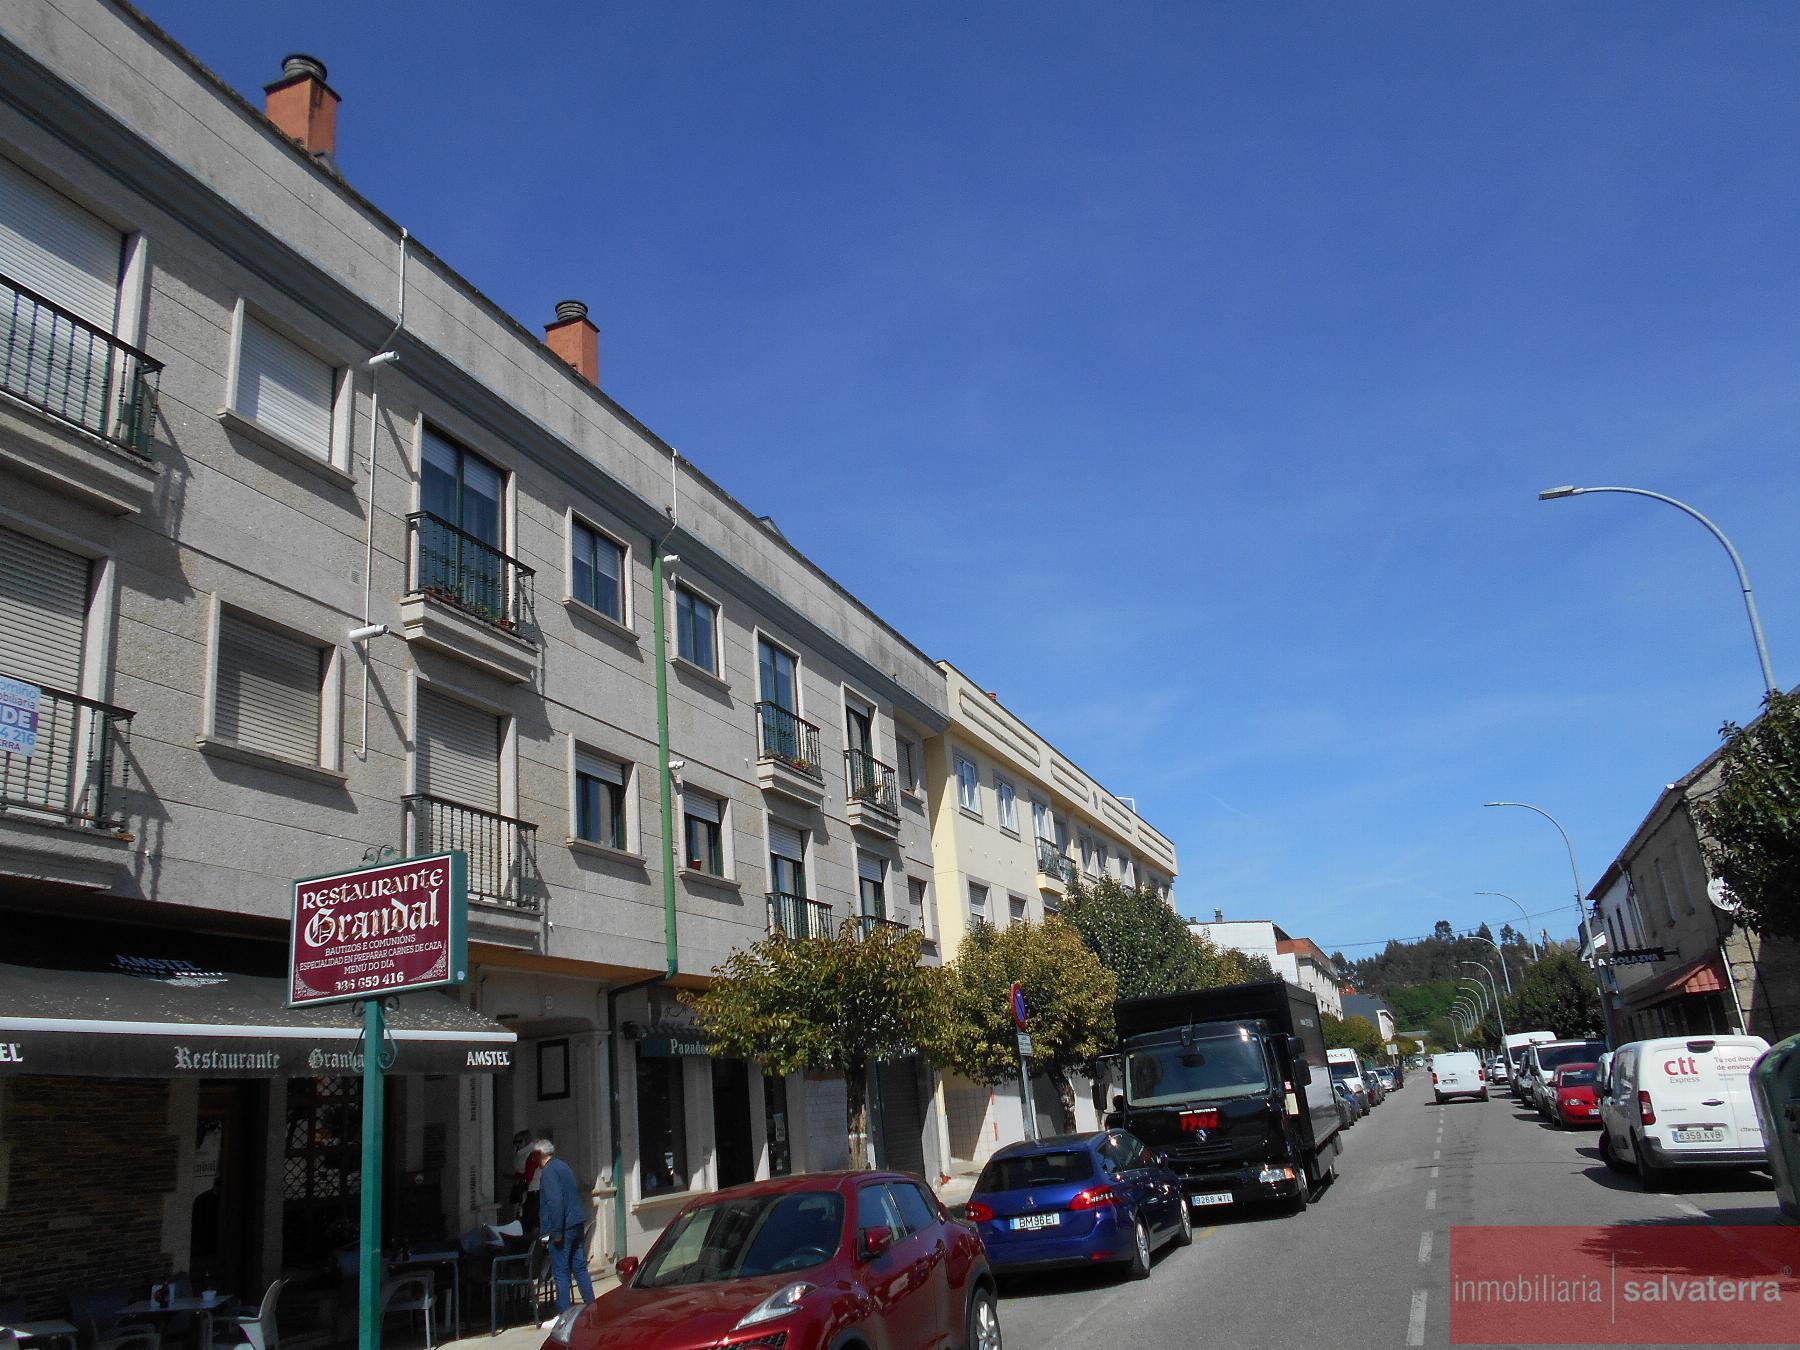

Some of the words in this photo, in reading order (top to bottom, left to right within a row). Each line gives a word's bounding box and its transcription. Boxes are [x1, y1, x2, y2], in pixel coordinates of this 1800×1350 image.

[0, 704, 31, 729] DE
[302, 868, 444, 910] RESTAURANTE
[304, 889, 440, 948] Grandal
[299, 956, 344, 971] ESPECIALIDAD
[344, 954, 353, 964] EN
[353, 949, 388, 963] PREPARAR
[388, 944, 415, 957] CARNES
[415, 943, 425, 953] DE
[424, 940, 443, 951] CAZA
[325, 942, 362, 957] BAUTIZOS
[362, 941, 368, 951] E
[368, 934, 416, 950] COMUNIÓNS
[344, 961, 367, 975] MENÚ
[368, 961, 379, 972] DO
[380, 958, 395, 970] DÍA
[358, 975, 380, 989] 659
[382, 972, 404, 986] 416
[174, 1046, 281, 1069] Restaurante
[308, 1048, 365, 1069] Granda
[466, 1050, 510, 1066] AMSTEL
[1664, 1056, 1698, 1076] ctt
[1680, 1130, 1702, 1140] 6359
